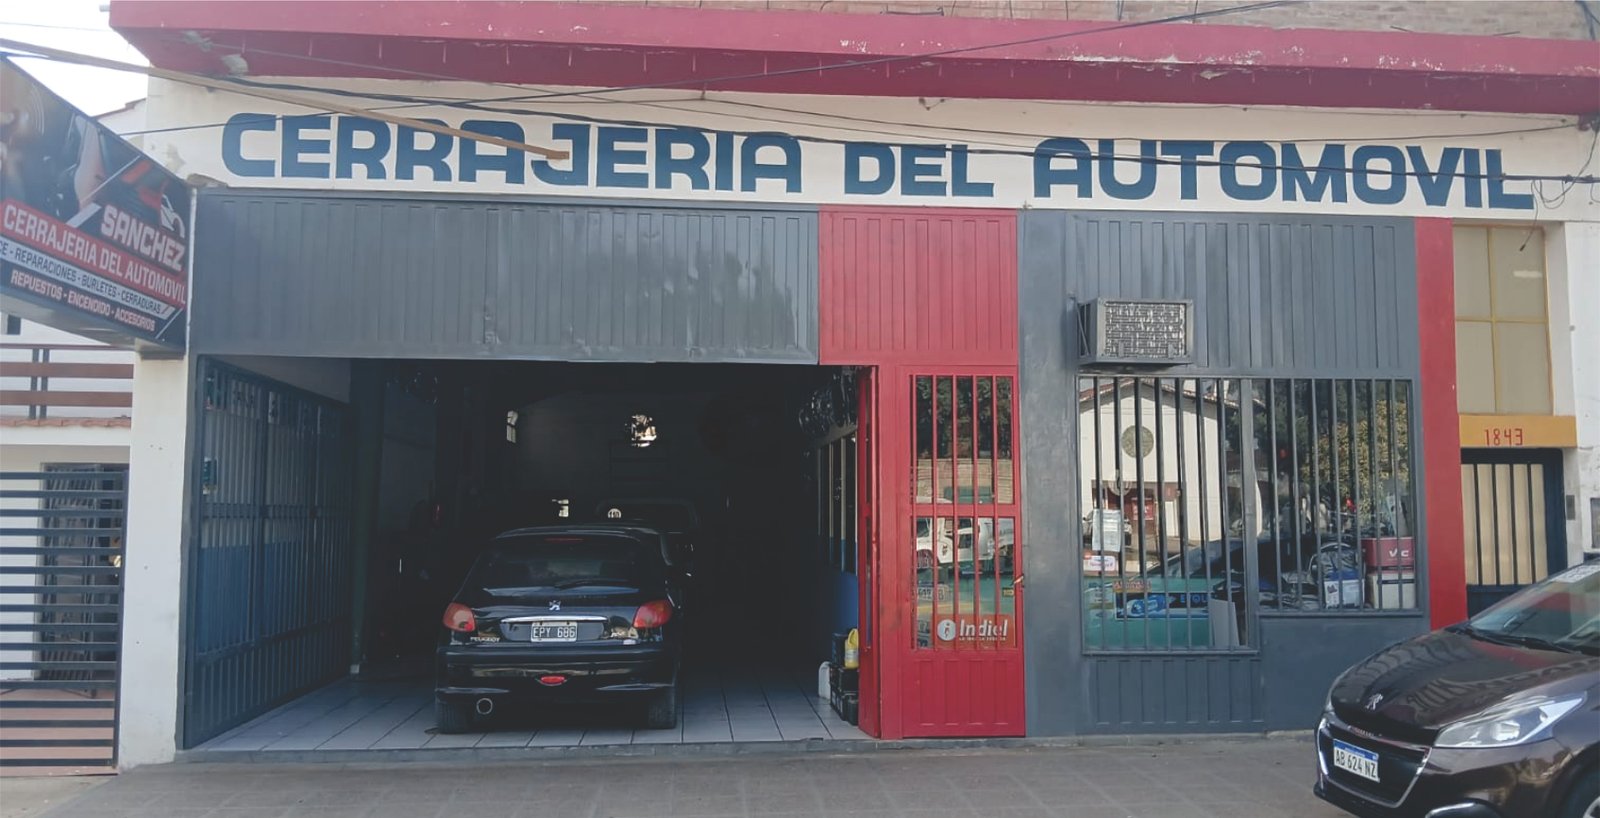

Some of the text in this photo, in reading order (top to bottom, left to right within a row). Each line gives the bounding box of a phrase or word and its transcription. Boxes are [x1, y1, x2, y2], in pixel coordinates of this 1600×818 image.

[222, 112, 1535, 210] CERRAJERIA DEL AUTOMOVIL
[4, 204, 186, 305] CERRAJERIA DEL AUTOMOVIL
[101, 204, 185, 272] SANCHEZ
[10, 269, 63, 301] REPUESTOS
[67, 290, 112, 317] ENCENDIDO
[15, 247, 77, 283] REPARACIONES
[81, 275, 118, 299] BURLETES
[1484, 428, 1523, 447] 1843
[533, 626, 576, 639] EPY 686
[1335, 749, 1346, 767] AB
[1347, 754, 1363, 773] 624
[1364, 760, 1376, 778] NZ
